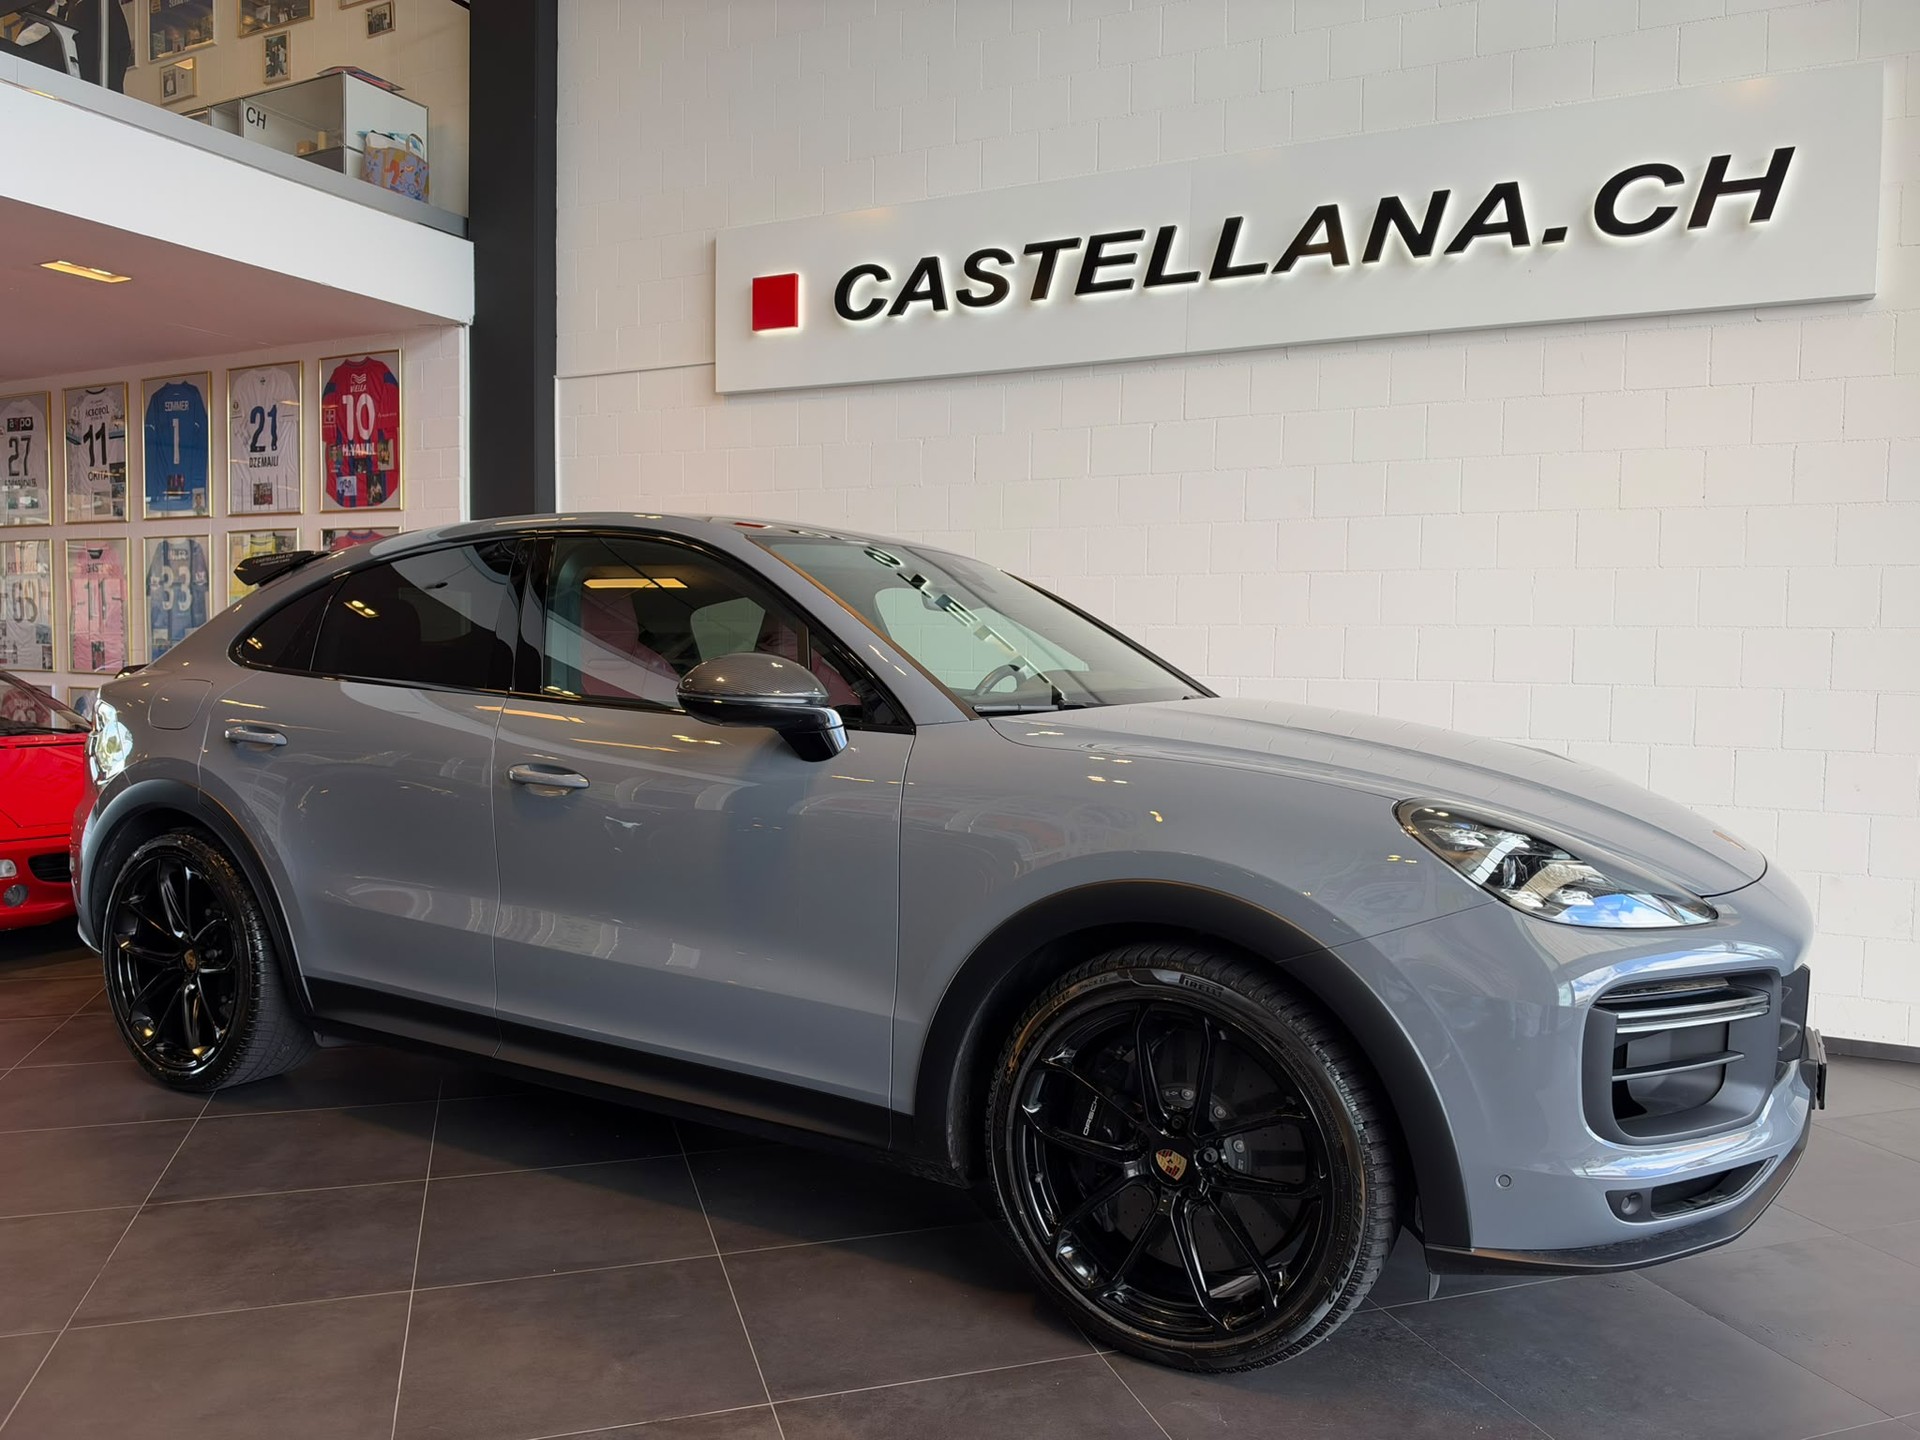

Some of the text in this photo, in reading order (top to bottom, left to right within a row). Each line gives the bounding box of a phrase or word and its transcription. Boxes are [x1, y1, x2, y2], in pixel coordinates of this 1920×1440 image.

[246, 106, 266, 130] CH
[250, 404, 278, 453] 21
[342, 393, 375, 440] 10
[8, 435, 31, 476] 27
[83, 421, 108, 467] 11
[172, 418, 180, 465] 1
[161, 565, 192, 611] 33
[1179, 974, 1226, 998] PIRELLI
[1082, 1095, 1099, 1136] ORSCH
